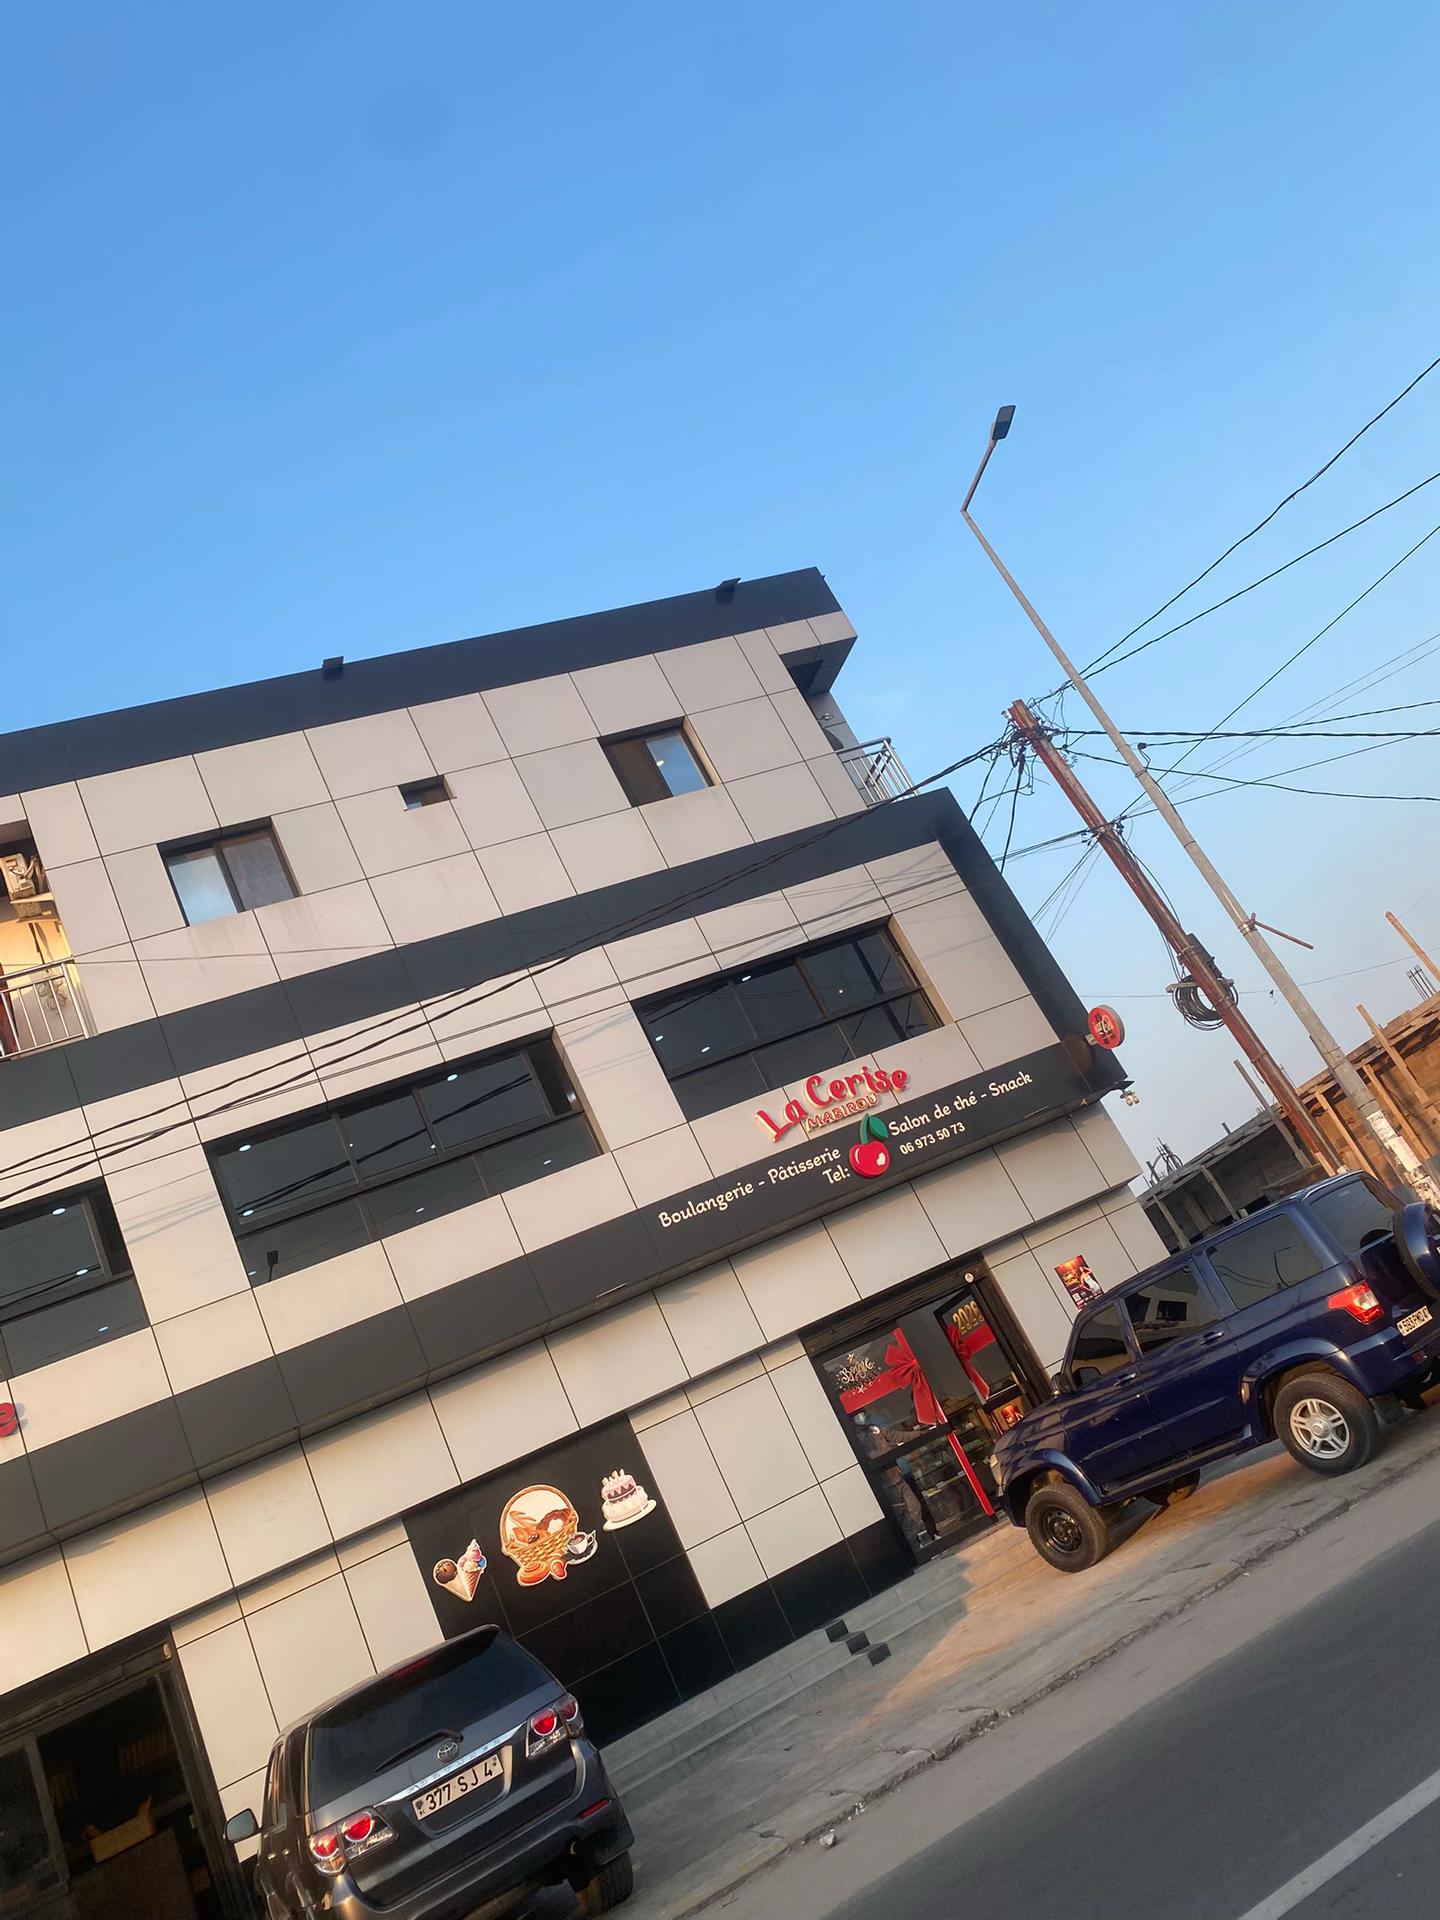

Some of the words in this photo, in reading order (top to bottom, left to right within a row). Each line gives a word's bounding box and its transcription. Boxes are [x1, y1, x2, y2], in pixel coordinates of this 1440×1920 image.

[755, 1099, 808, 1142] La
[804, 1065, 908, 1109] Cerise
[806, 1093, 879, 1132] MABIROU
[888, 1115, 931, 1136] Salon
[934, 1103, 952, 1119] de
[953, 1091, 978, 1111] thé
[988, 1071, 1033, 1097] Snack
[822, 1164, 851, 1185] Tel:
[899, 1141, 915, 1155] 06
[915, 1133, 936, 1148] 973
[935, 1127, 951, 1141] 50
[950, 1121, 966, 1135] 73
[658, 1181, 754, 1228] Boulangerie
[767, 1147, 841, 1184] Pâtisserie
[425, 1783, 451, 1810] 377
[457, 1768, 479, 1792] SJ
[484, 1762, 493, 1777] 4
